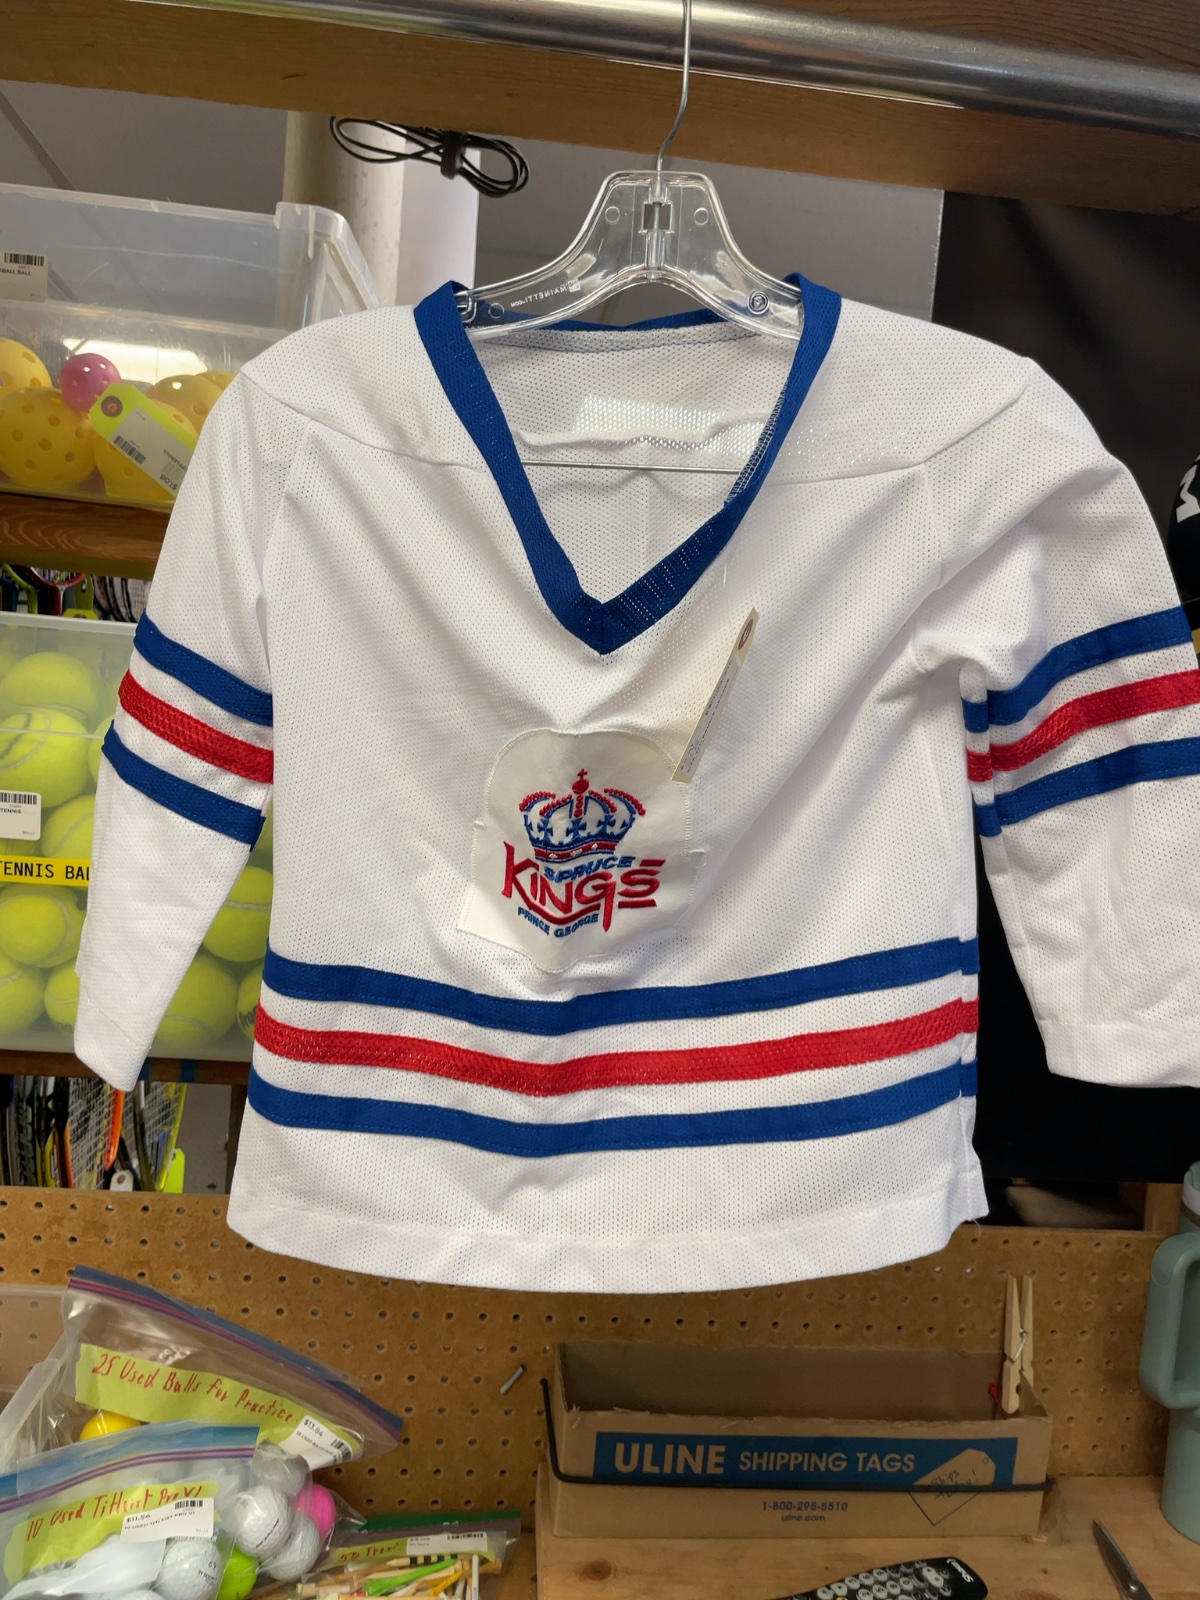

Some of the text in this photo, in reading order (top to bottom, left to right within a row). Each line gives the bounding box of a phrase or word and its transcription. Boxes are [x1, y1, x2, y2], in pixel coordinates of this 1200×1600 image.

[0, 860, 55, 878] ENNIS
[543, 855, 636, 884] SPRUCE
[517, 906, 600, 938] PRINCE GEORGE
[92, 1353, 121, 1376] 25
[120, 1359, 161, 1389] Used
[614, 1442, 916, 1475] ULINE SHIPPING TAGS
[762, 1501, 849, 1512] 1-800-295-5510
